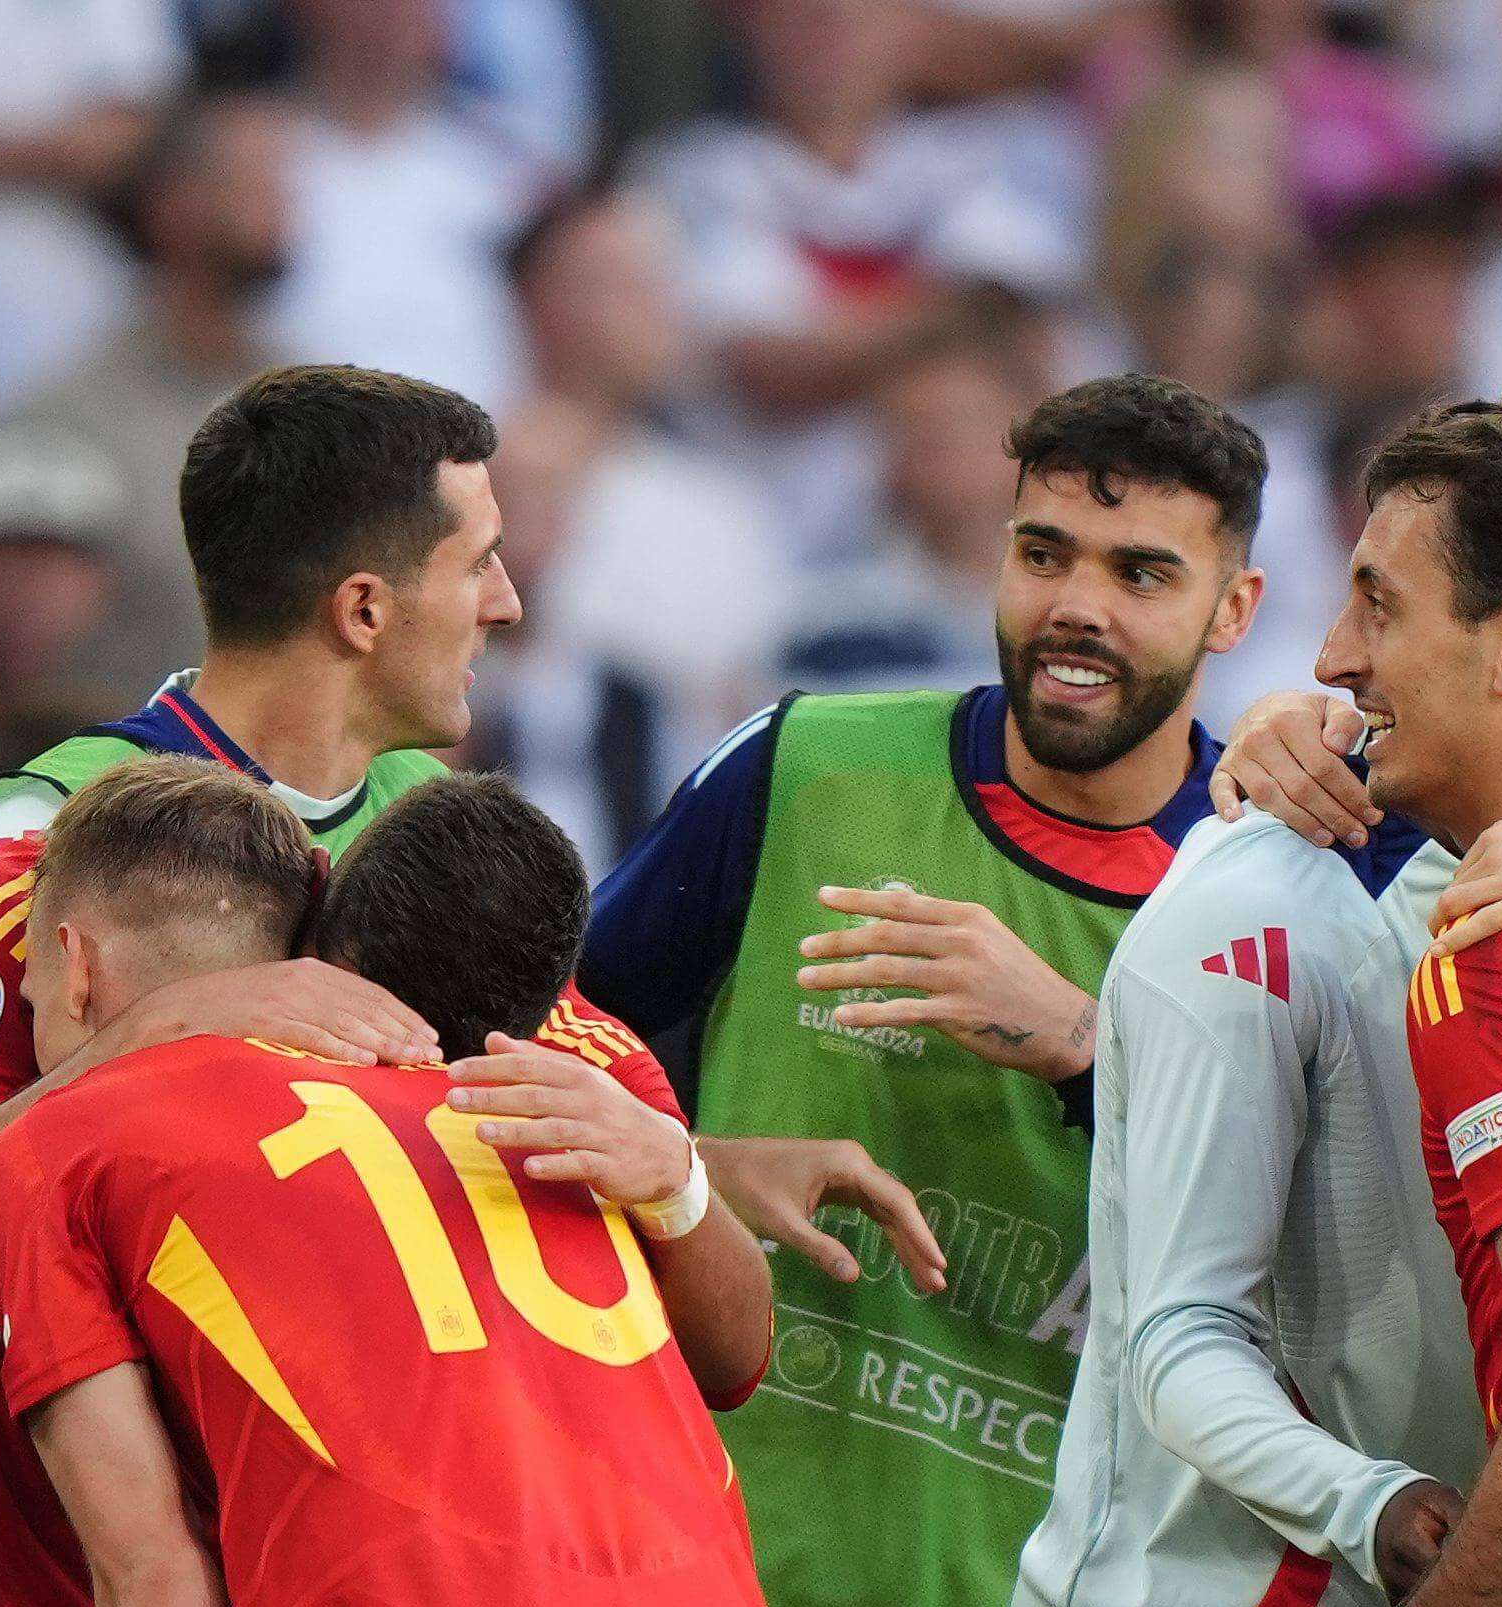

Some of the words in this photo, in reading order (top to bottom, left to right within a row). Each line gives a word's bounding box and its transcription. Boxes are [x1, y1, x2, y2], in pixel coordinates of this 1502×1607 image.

[798, 1003, 927, 1058] EU2024
[257, 1080, 670, 1367] 10
[858, 1351, 1063, 1465] RESPEC
